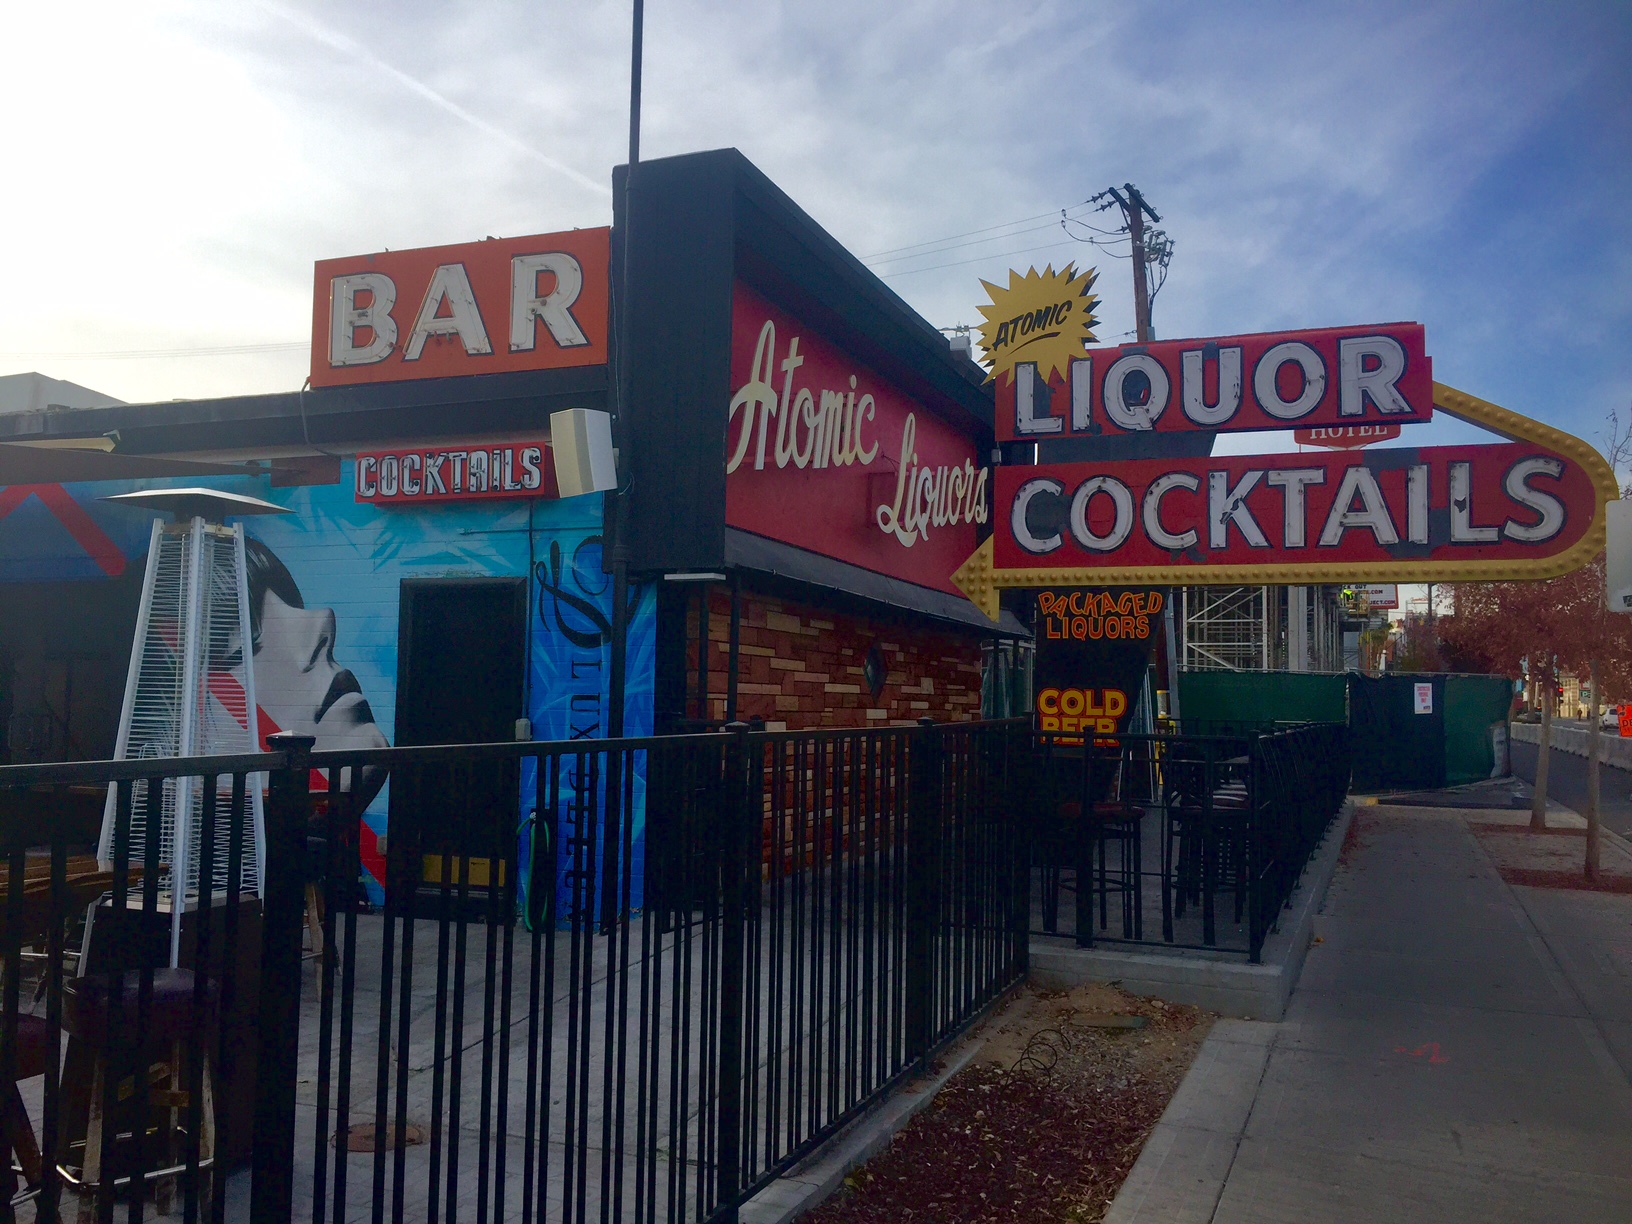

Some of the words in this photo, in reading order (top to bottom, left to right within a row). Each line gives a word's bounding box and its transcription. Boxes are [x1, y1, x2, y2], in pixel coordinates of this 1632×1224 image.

[327, 252, 593, 368] BAR
[992, 300, 1073, 350] ATOMIC
[727, 319, 879, 475] Atomic
[1015, 334, 1414, 435] LIQUOR
[1310, 425, 1388, 439] HOTEL
[356, 448, 542, 497] COCKTAILS
[876, 412, 988, 547] Liquors
[1010, 454, 1566, 554] COCKTAILS
[1038, 591, 1163, 620] PACKAGED
[1046, 616, 1150, 641] LIQUORS
[1038, 688, 1127, 718] COLD
